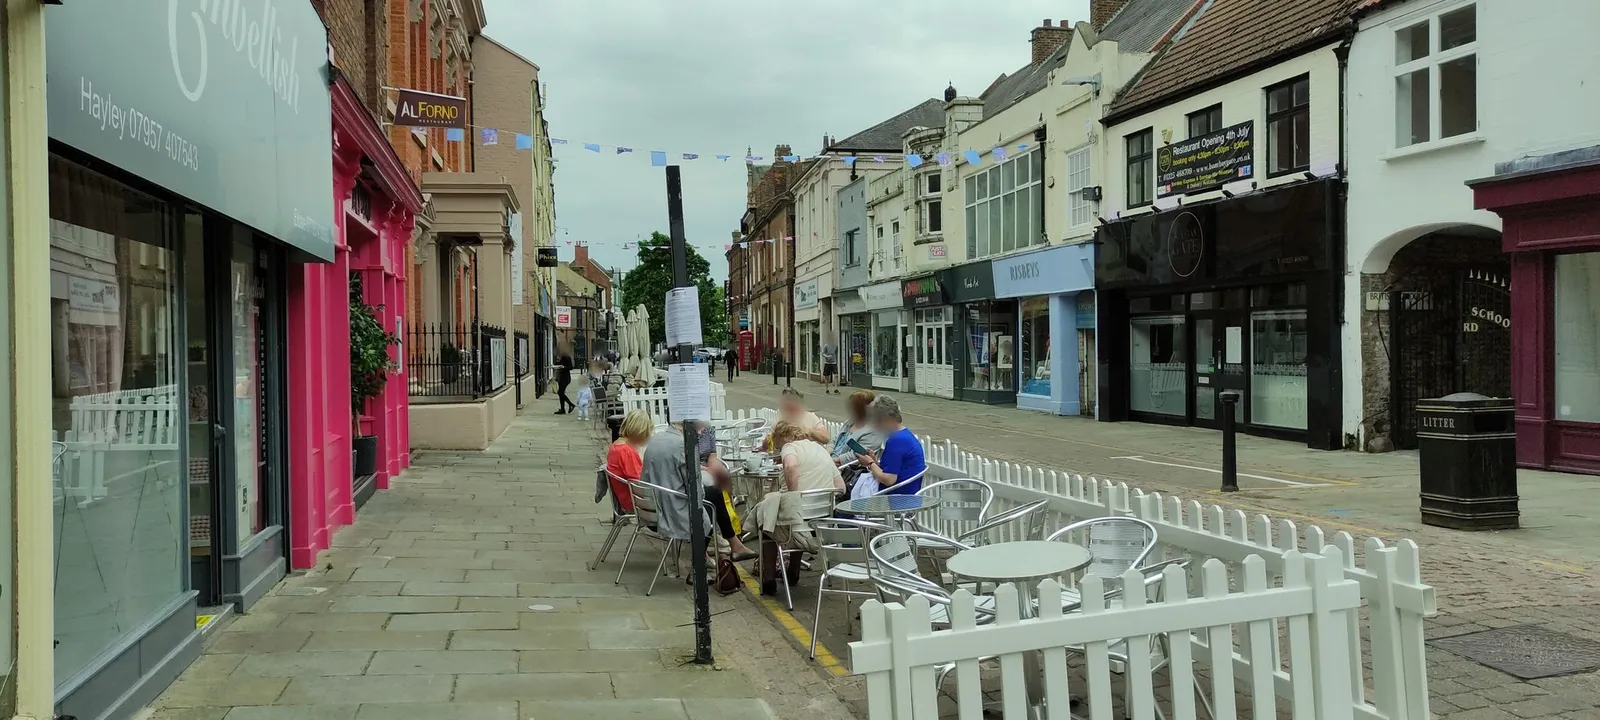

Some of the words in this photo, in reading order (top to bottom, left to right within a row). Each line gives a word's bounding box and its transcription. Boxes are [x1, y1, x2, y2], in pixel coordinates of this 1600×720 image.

[81, 76, 126, 140] Hayley
[129, 107, 163, 152] 07957
[165, 130, 198, 171] 407543
[1172, 142, 1200, 156] Restaurant
[1201, 134, 1225, 149] Opening
[1226, 130, 1236, 140] 4th
[1237, 126, 1250, 138] July
[1172, 157, 1188, 166] booking
[1009, 261, 1040, 281] RISBEYS
[1370, 292, 1391, 300] BRITIS
[1471, 306, 1511, 328] SCHOO
[1423, 416, 1455, 428] LITTER
